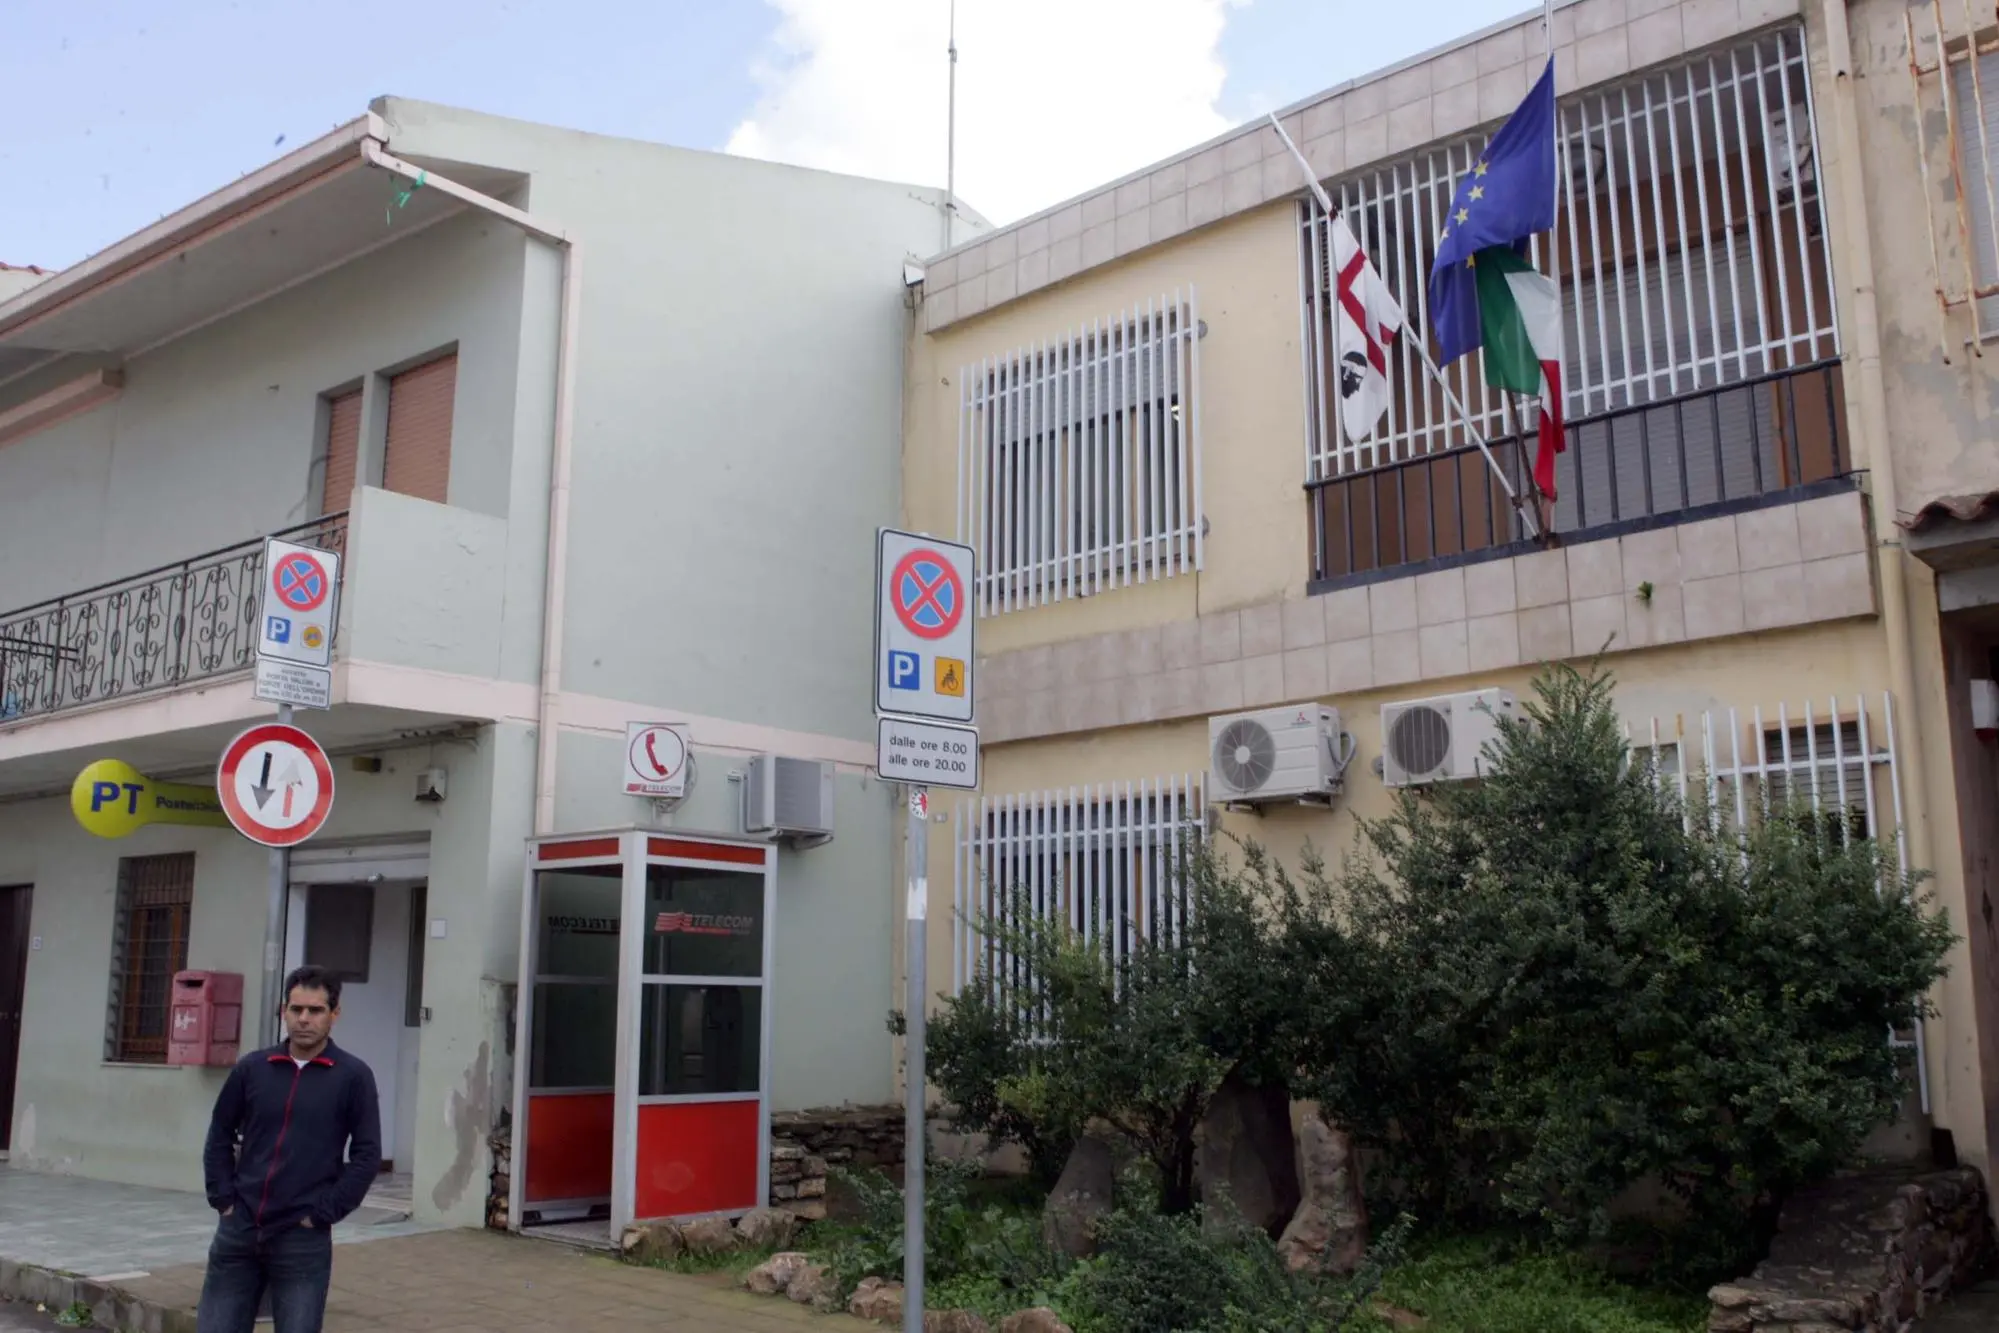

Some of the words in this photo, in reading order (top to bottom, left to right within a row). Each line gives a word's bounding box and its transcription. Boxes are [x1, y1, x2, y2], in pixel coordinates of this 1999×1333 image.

[270, 619, 287, 640] P
[894, 653, 914, 686] P
[889, 735, 916, 749] dalle
[920, 740, 938, 751] ore
[942, 741, 967, 755] 8.00
[888, 754, 908, 766] alle
[912, 758, 930, 769] ore
[935, 759, 966, 773] 20.00
[91, 781, 144, 815] PT
[693, 914, 753, 928] TELECOM
